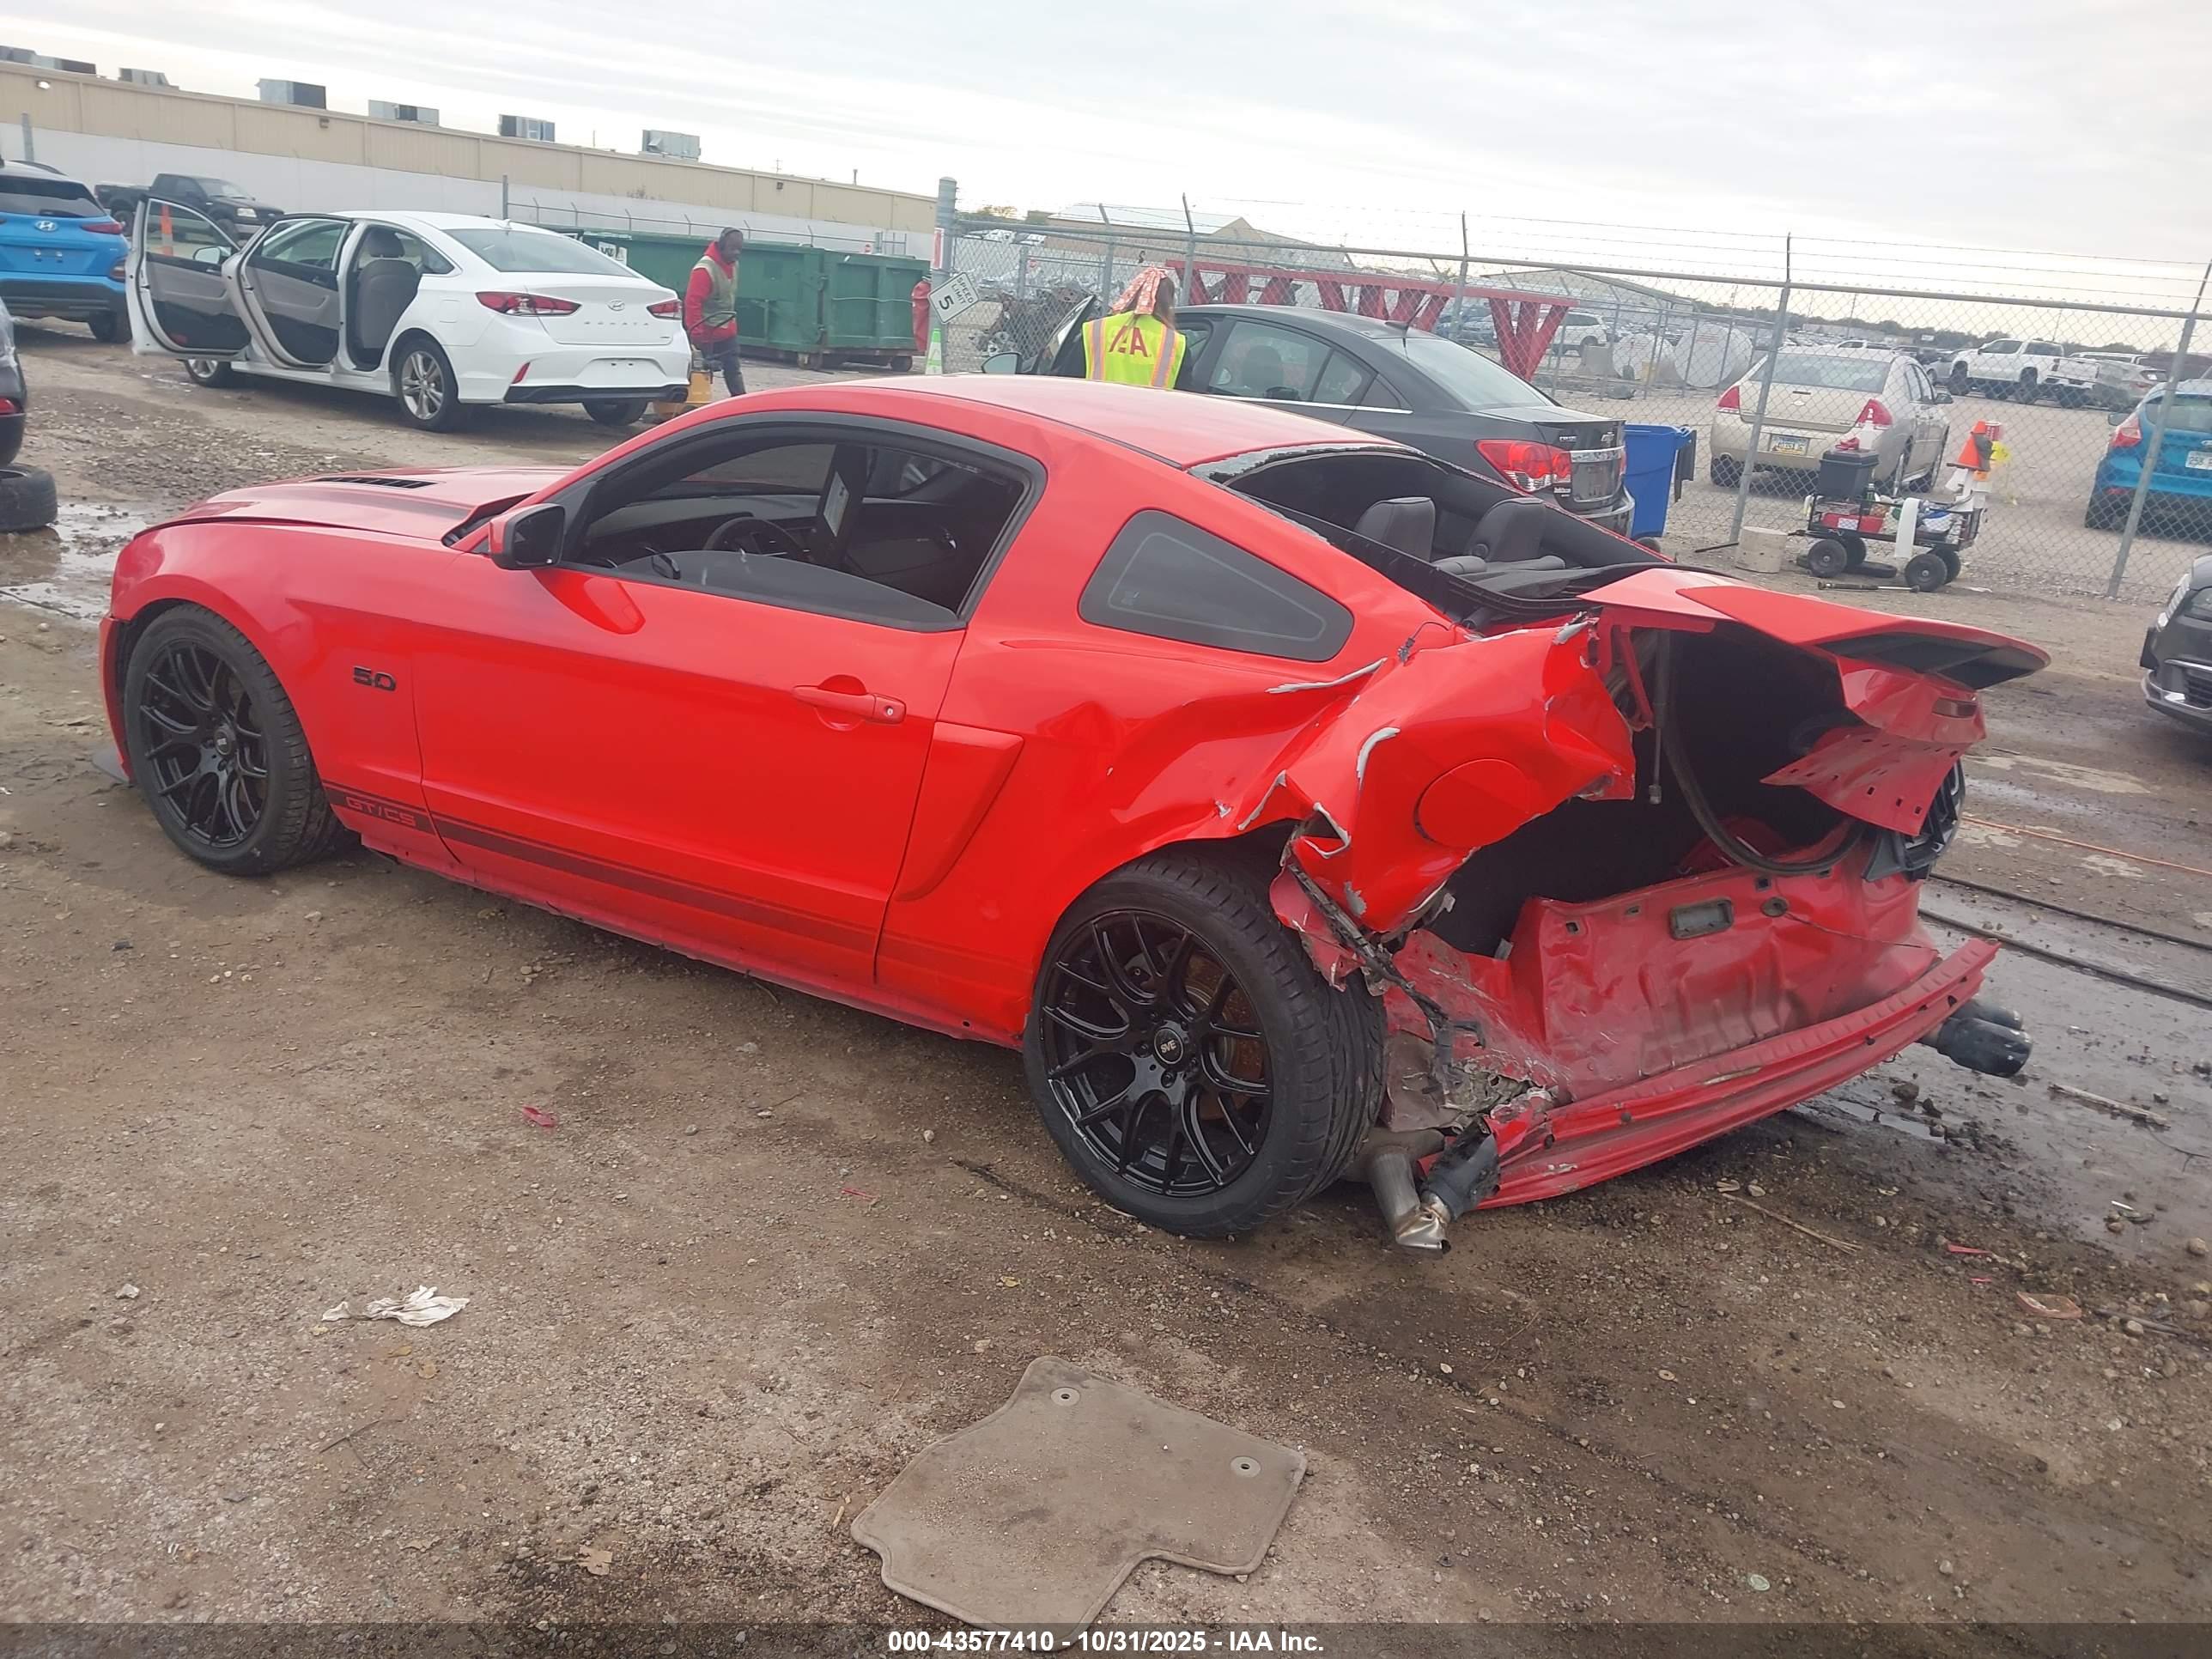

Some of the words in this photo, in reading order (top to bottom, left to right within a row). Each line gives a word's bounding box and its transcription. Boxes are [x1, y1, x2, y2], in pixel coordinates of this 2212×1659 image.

[951, 283, 966, 304] LIMIT
[957, 276, 974, 303] SPEED
[939, 295, 954, 310] 5
[1160, 1039, 1176, 1054] SVE
